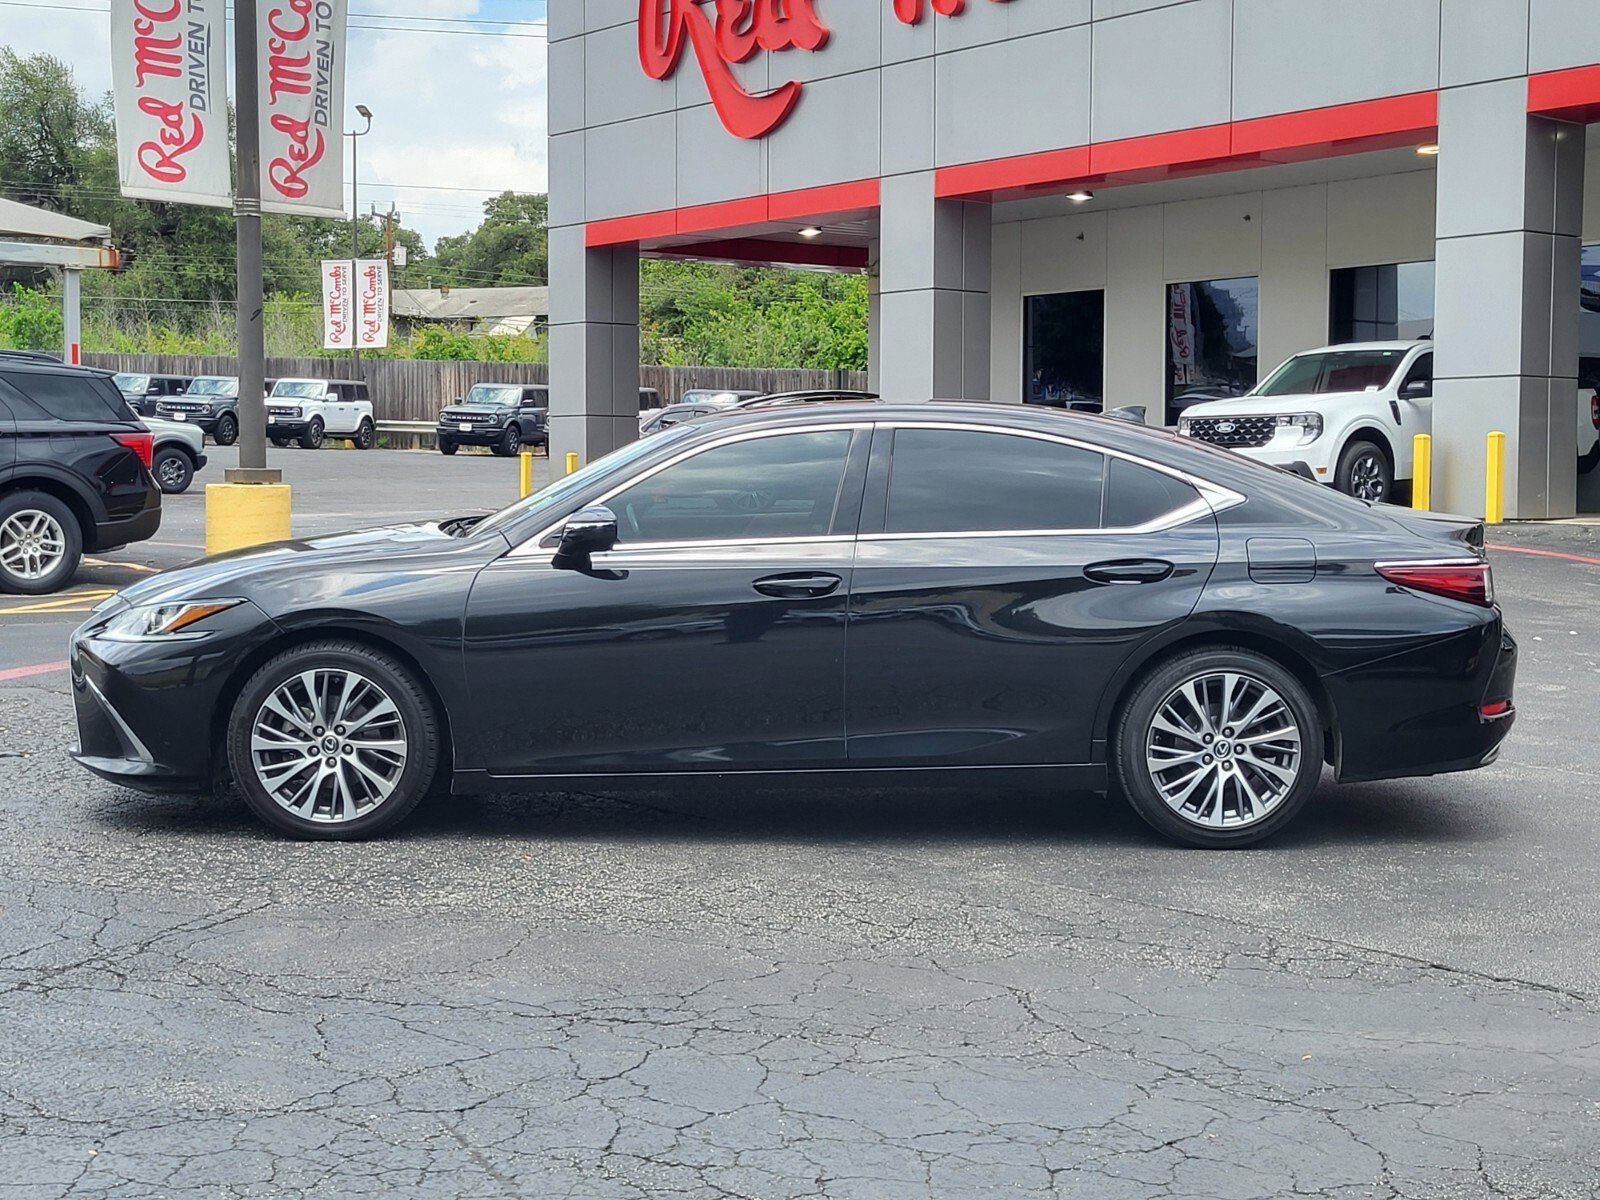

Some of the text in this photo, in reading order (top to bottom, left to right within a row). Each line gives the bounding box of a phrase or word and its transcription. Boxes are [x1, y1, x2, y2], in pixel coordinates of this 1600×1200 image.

[187, 0, 206, 112] DRIVEN T
[315, 1, 333, 127] DRIVEN TO
[137, 96, 204, 183] Red
[268, 113, 325, 199] Red
[329, 265, 347, 343] Red McCombs
[342, 287, 347, 296] TO
[362, 265, 381, 343] Red McCombs
[377, 287, 383, 296] TO
